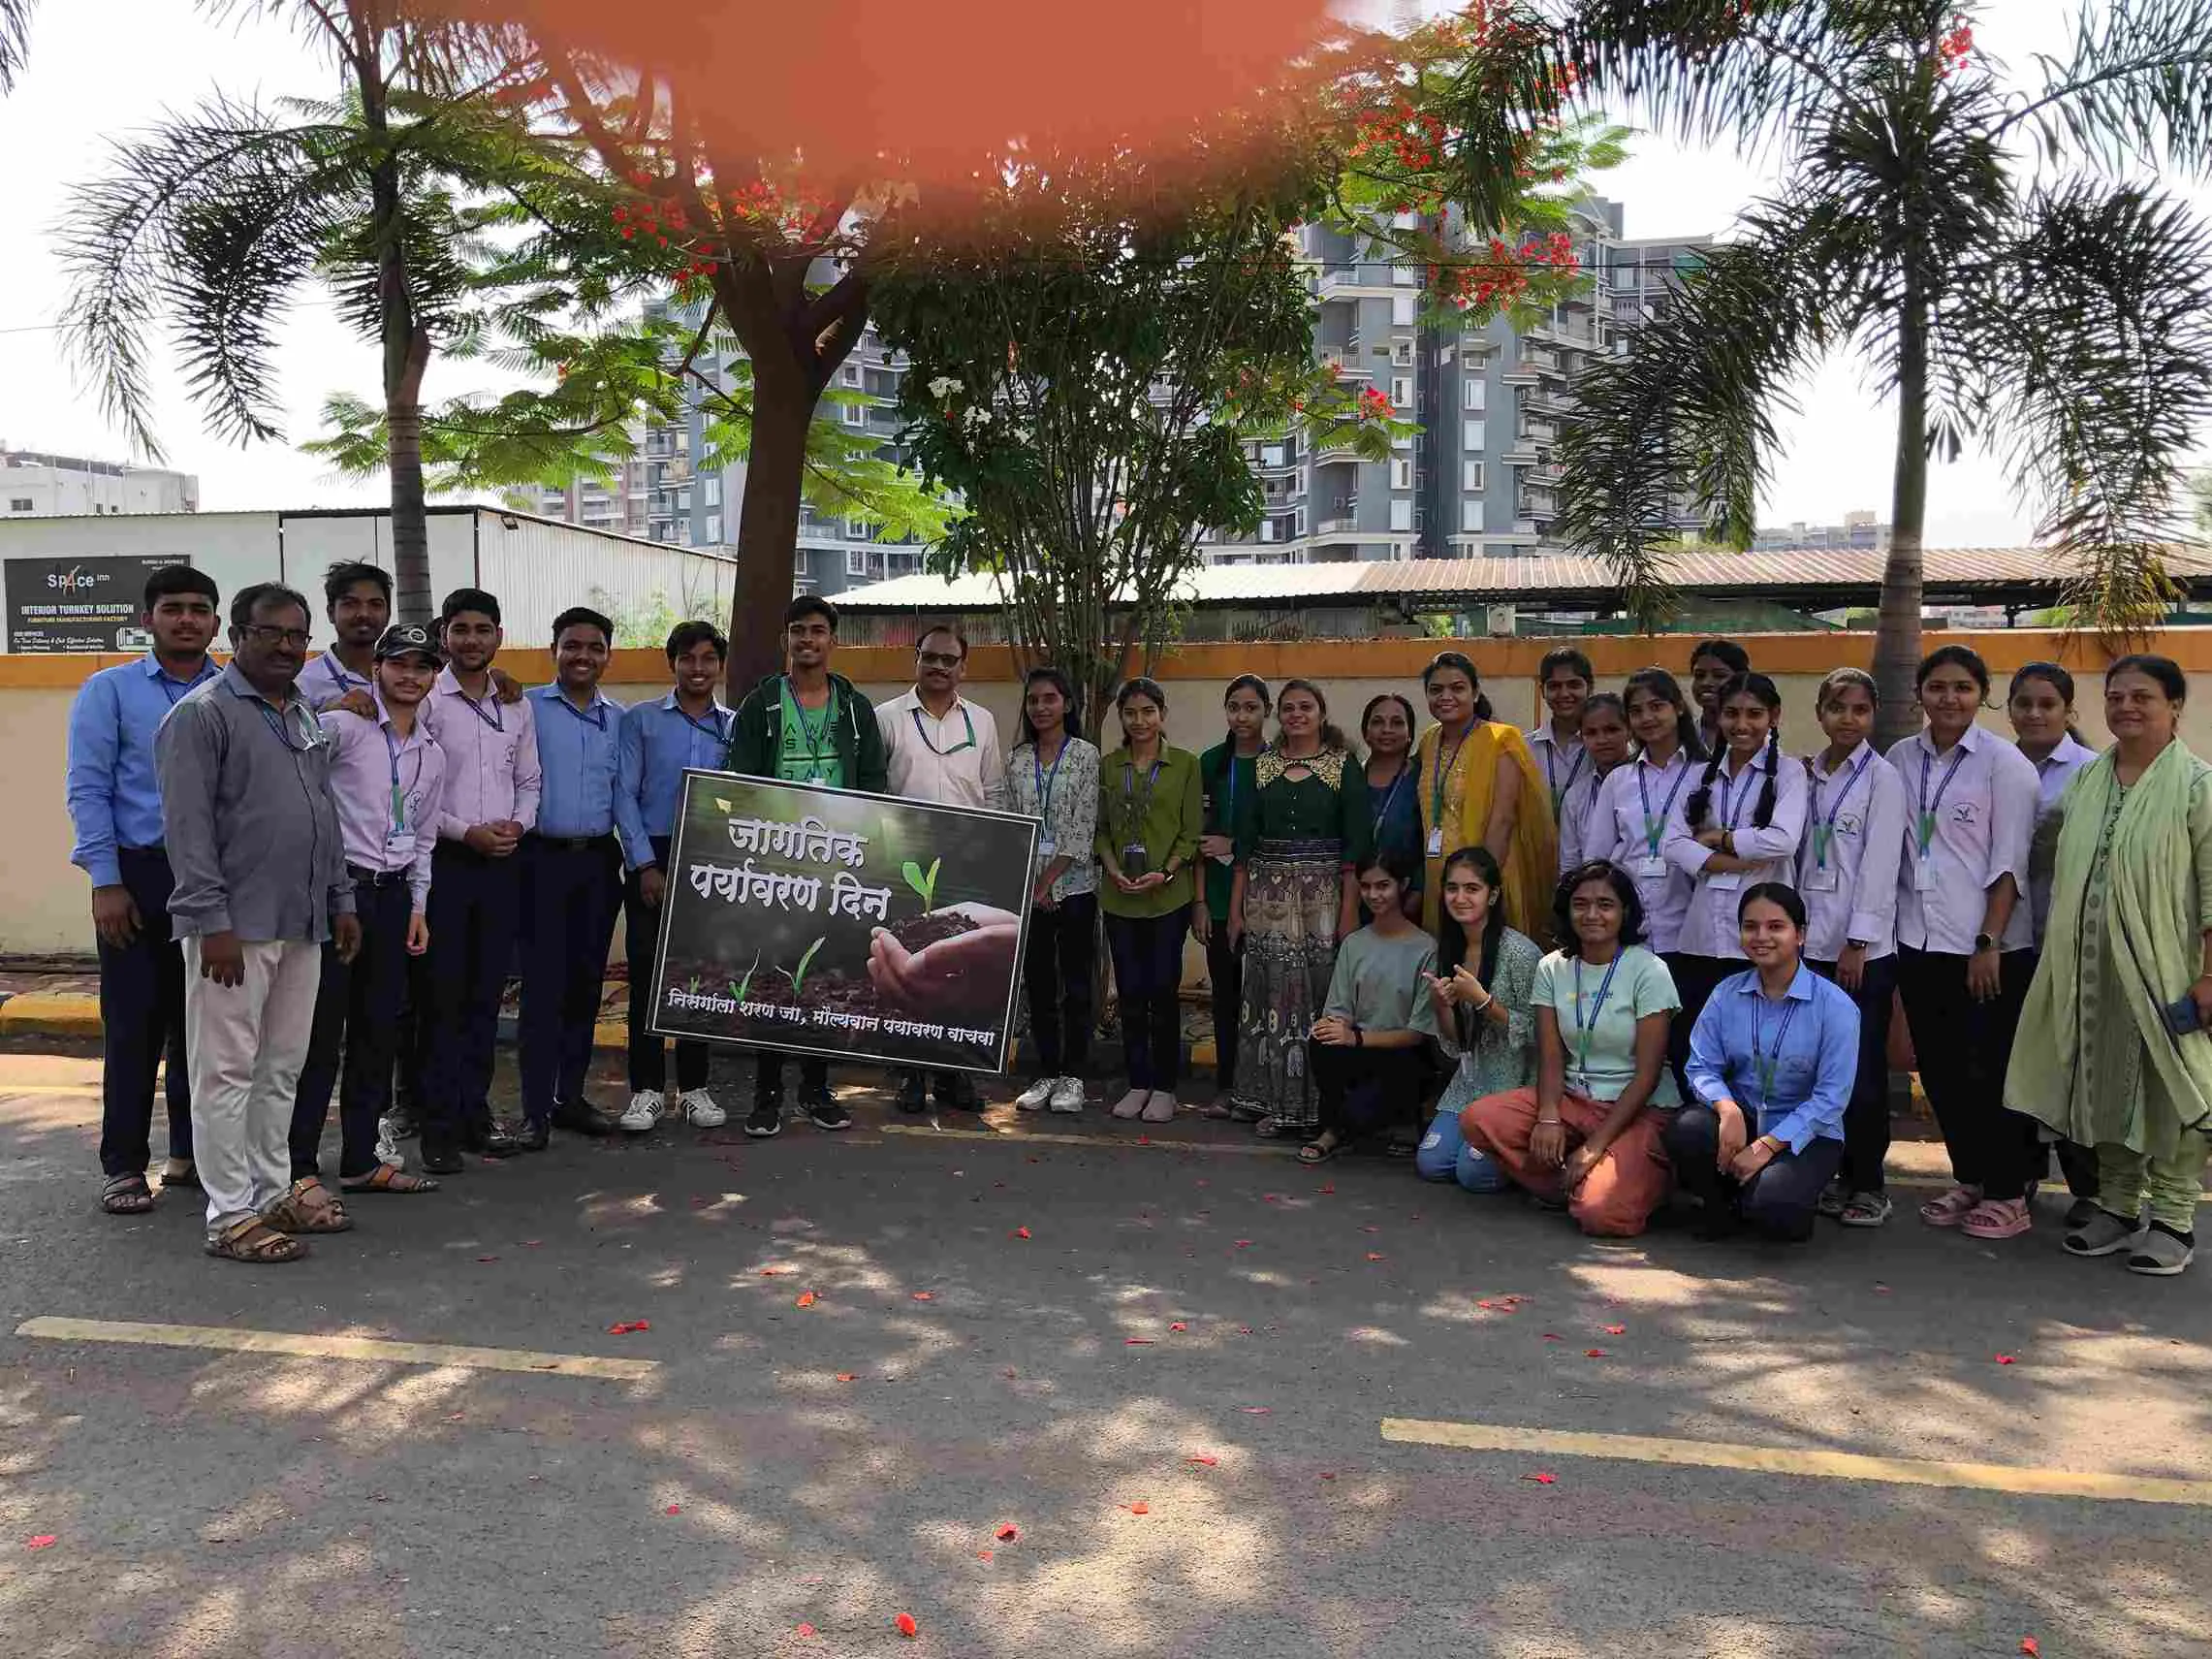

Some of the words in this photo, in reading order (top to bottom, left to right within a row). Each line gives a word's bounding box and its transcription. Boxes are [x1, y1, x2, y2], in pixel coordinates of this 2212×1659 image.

[21, 605, 57, 615] INTERIOR
[59, 604, 94, 614] TURNKEY
[96, 604, 134, 614] SOLUTION
[728, 815, 869, 869] जागतिक
[690, 858, 822, 911] पर्यावरण
[829, 871, 893, 921] दिन
[667, 987, 736, 1015] निसर्गाला
[740, 1000, 775, 1019] शरण
[812, 1005, 878, 1032] मौल्यवान
[947, 1027, 995, 1047] वाचवा
